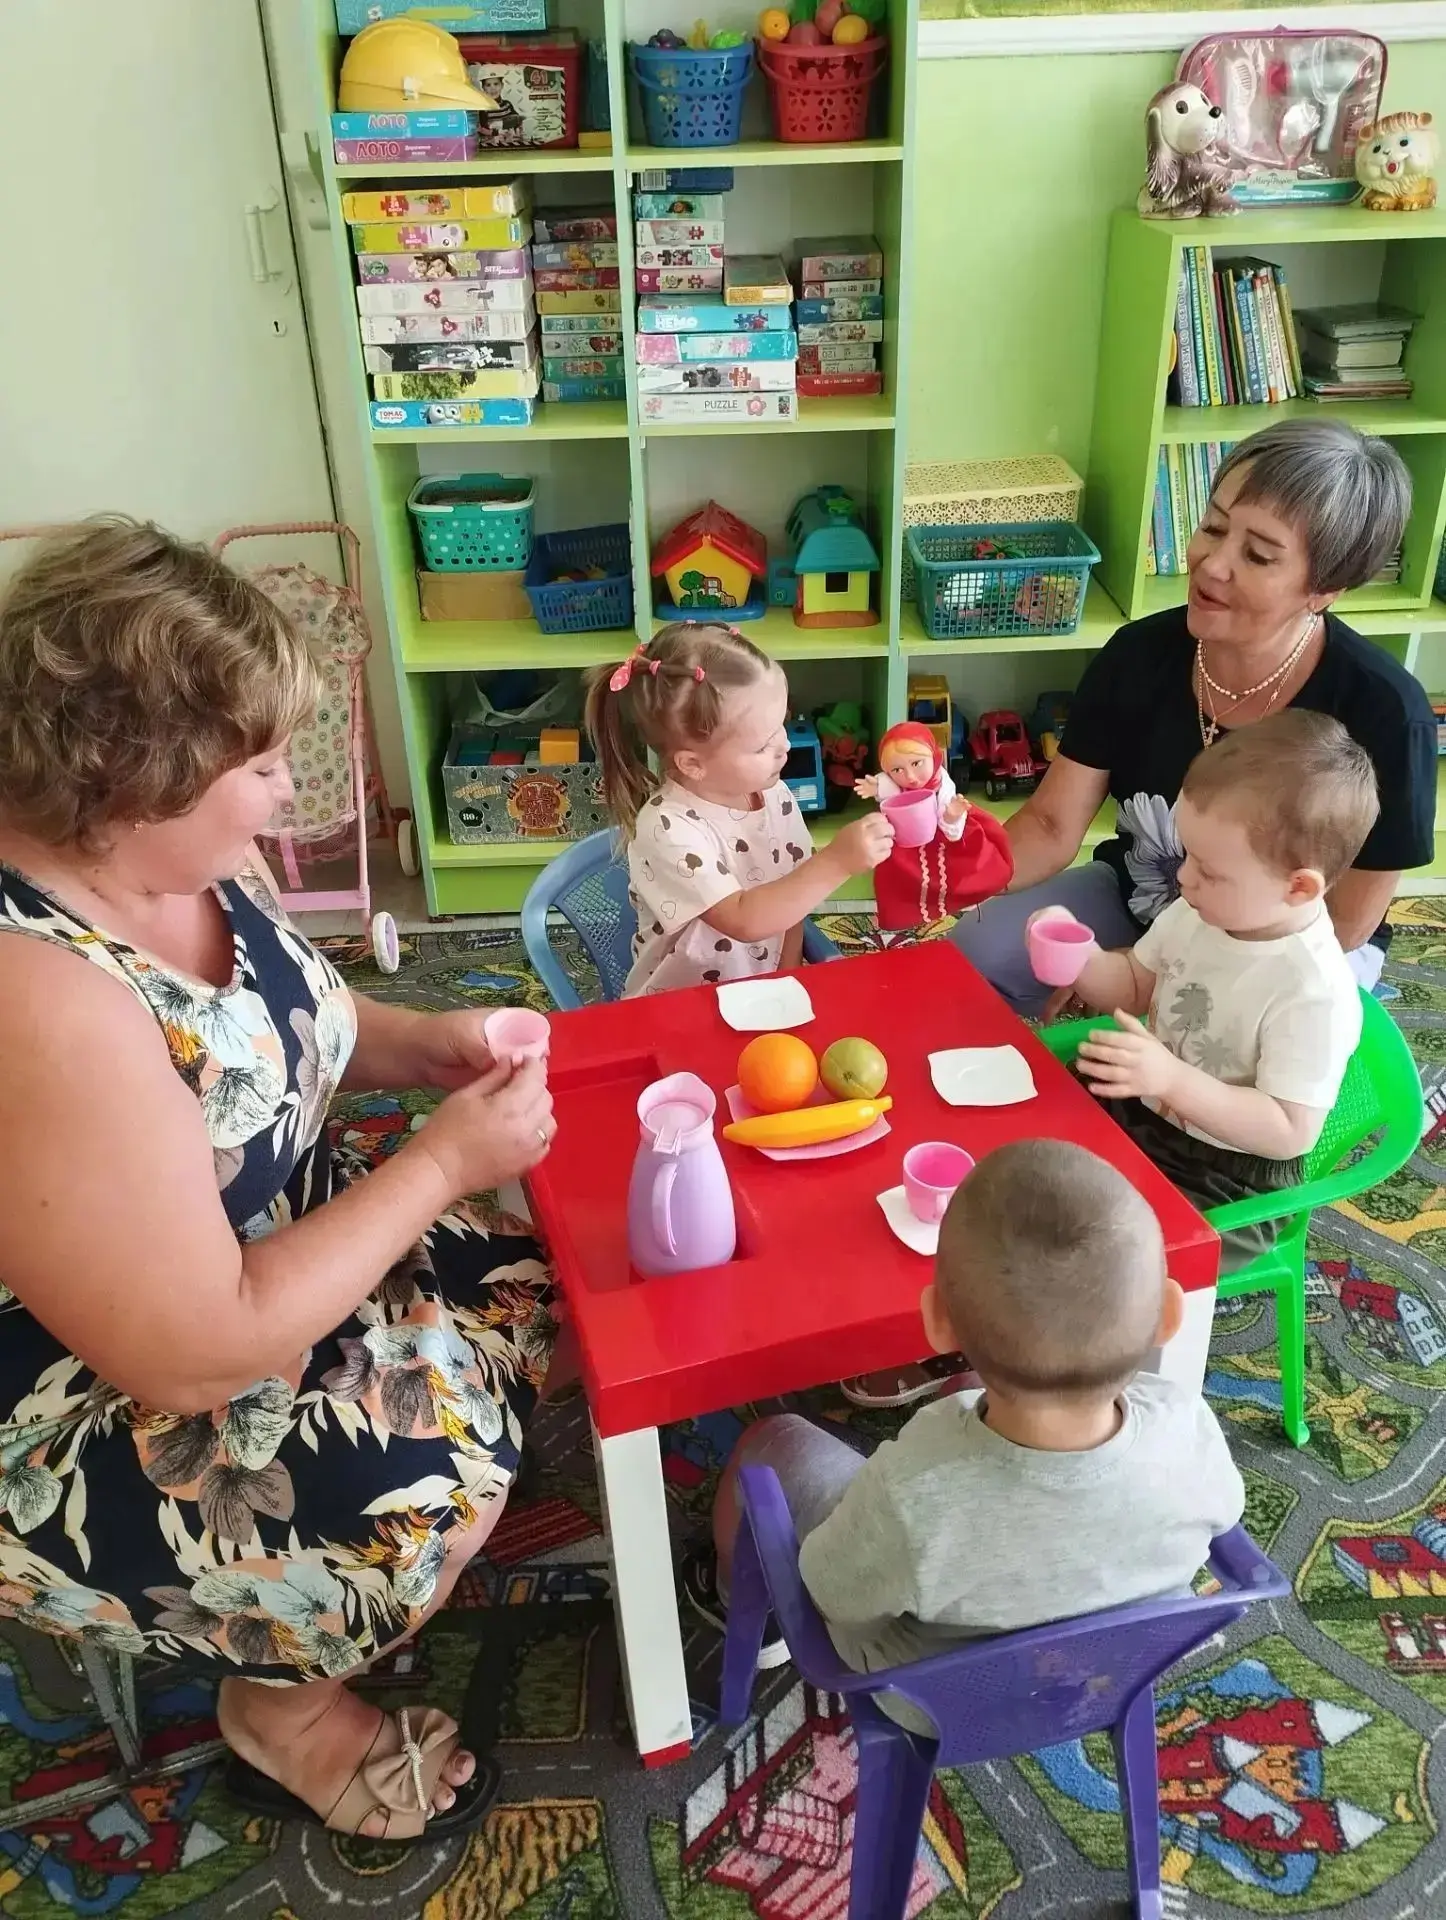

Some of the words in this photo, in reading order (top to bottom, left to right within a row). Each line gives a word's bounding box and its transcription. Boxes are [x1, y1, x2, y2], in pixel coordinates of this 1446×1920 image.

[368, 114, 408, 129] ЛОТО
[356, 141, 400, 158] ЛОТО
[704, 400, 738, 409] PUZZLE
